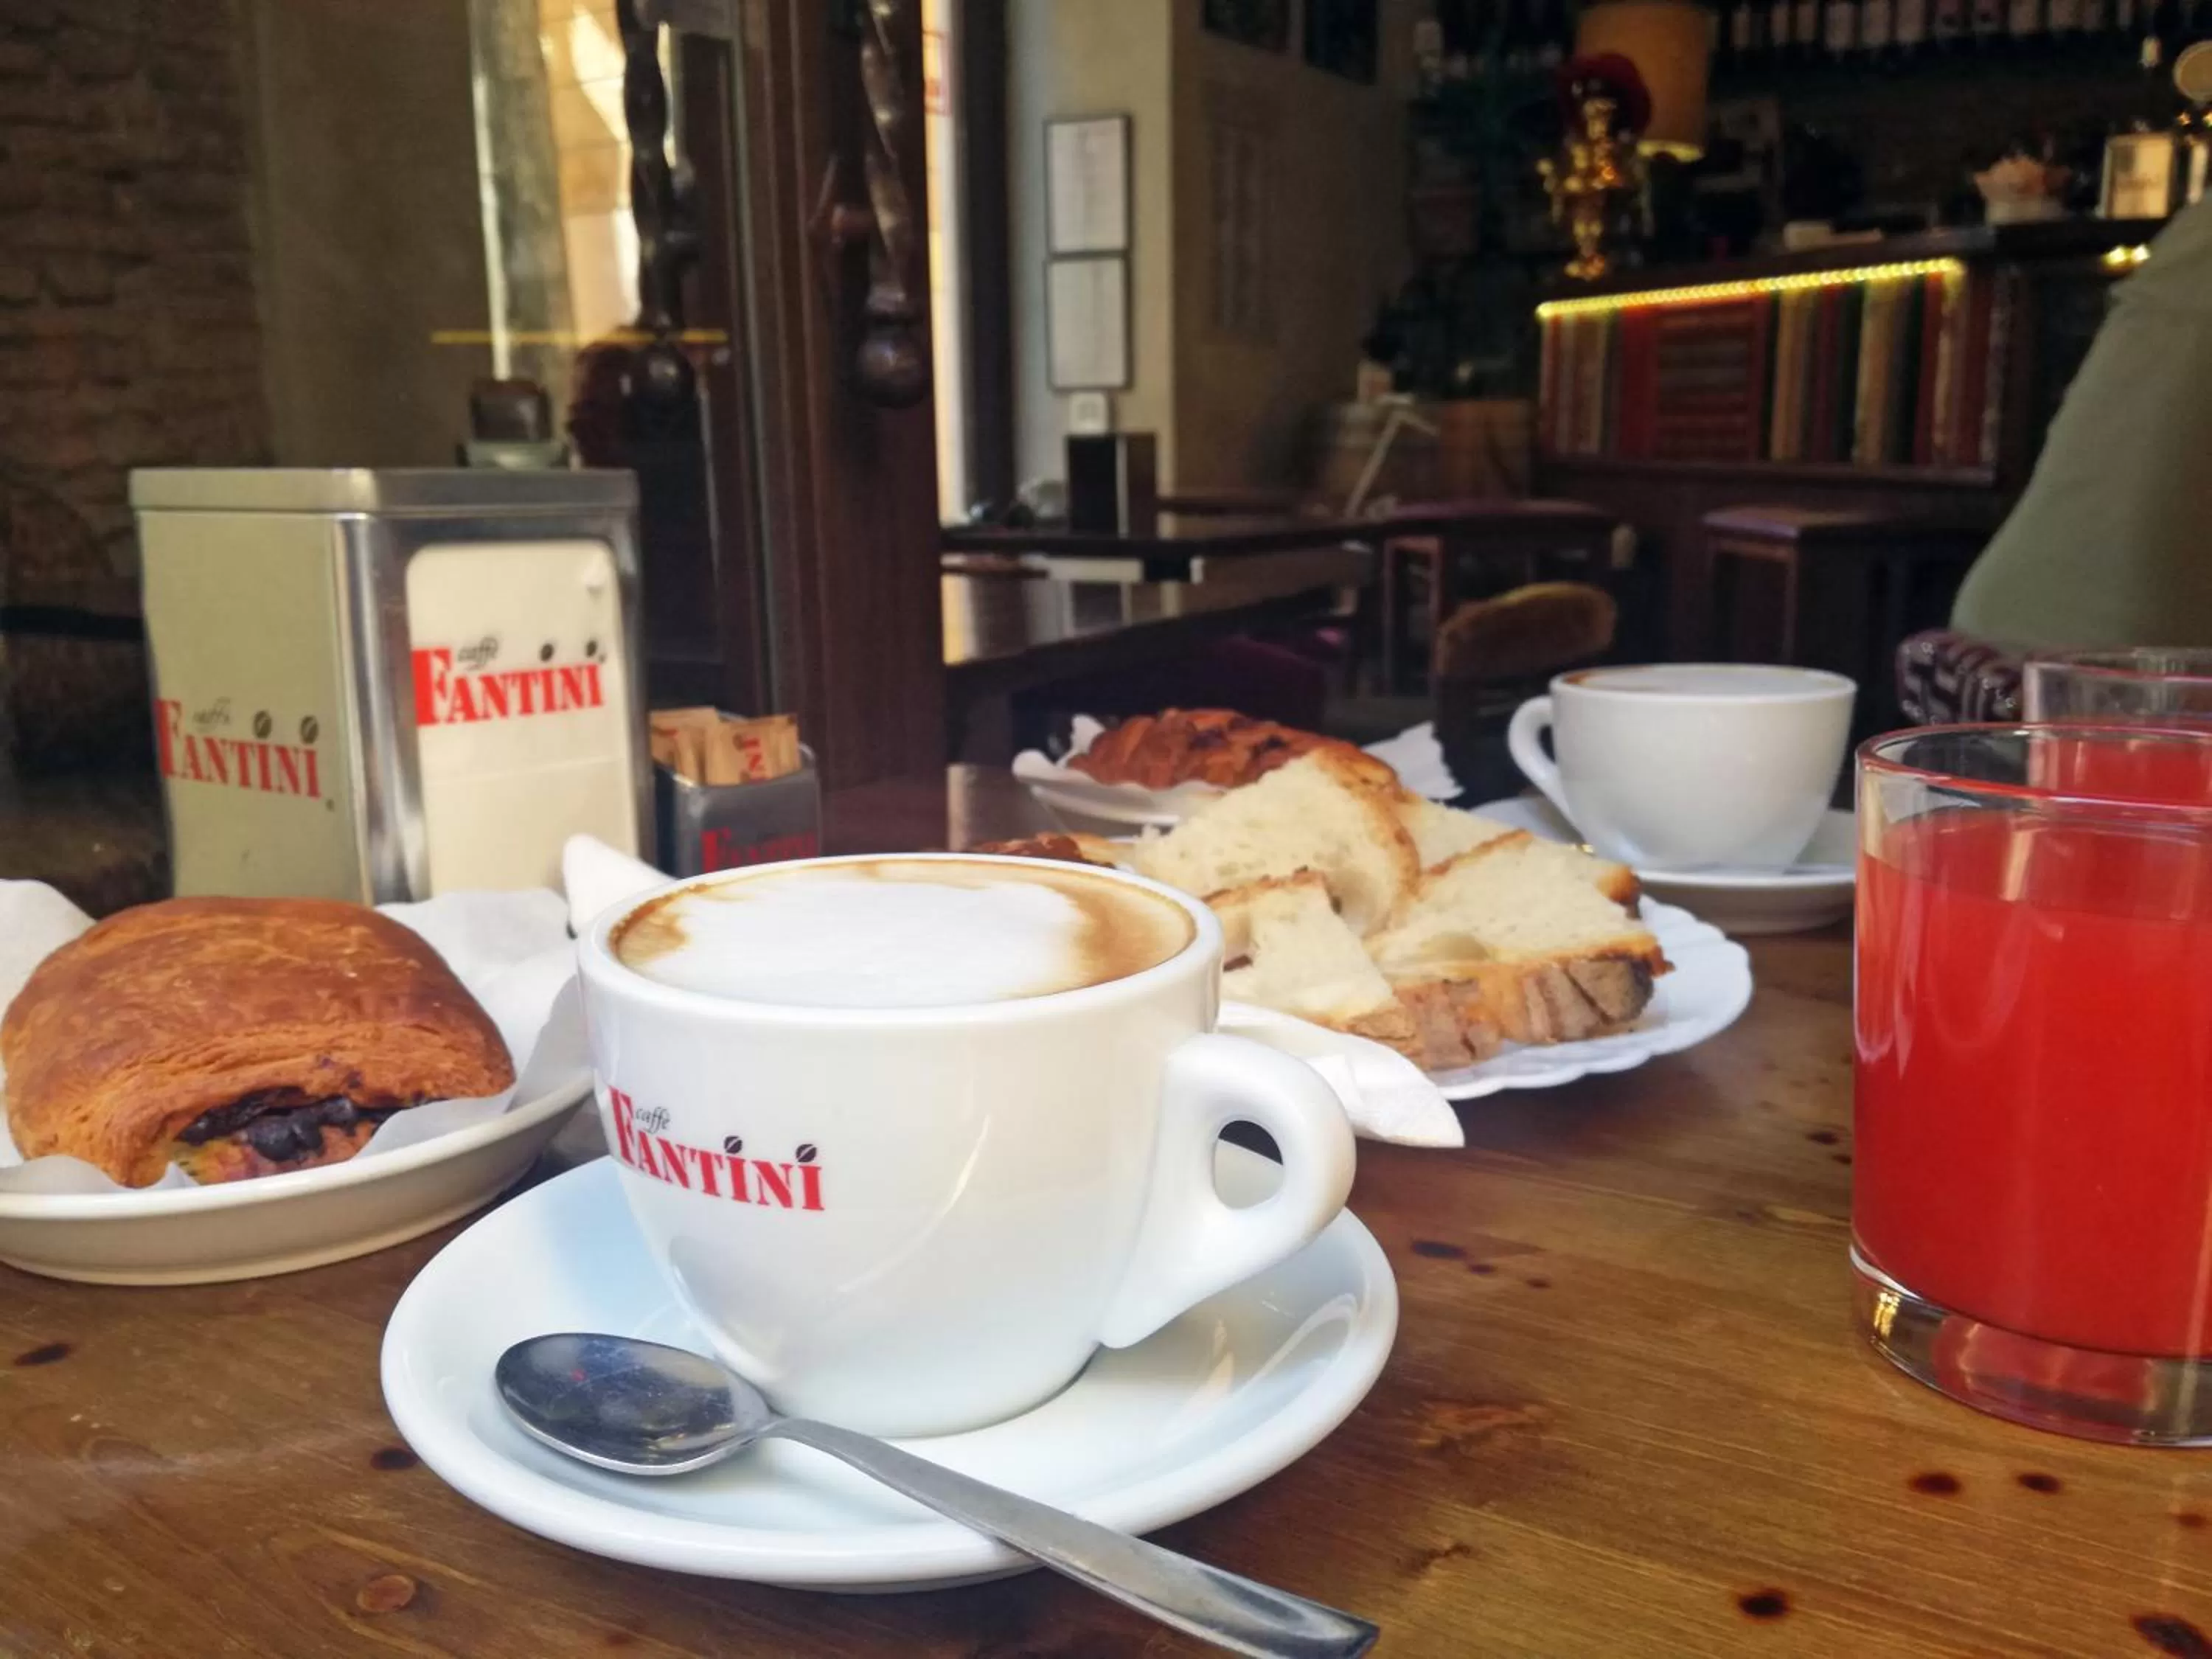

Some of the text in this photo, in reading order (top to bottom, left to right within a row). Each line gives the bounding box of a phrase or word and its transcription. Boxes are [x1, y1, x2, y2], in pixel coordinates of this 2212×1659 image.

[411, 647, 603, 727] FANTINI
[153, 698, 321, 799] FANTINI
[609, 1085, 824, 1211] FANTINI
